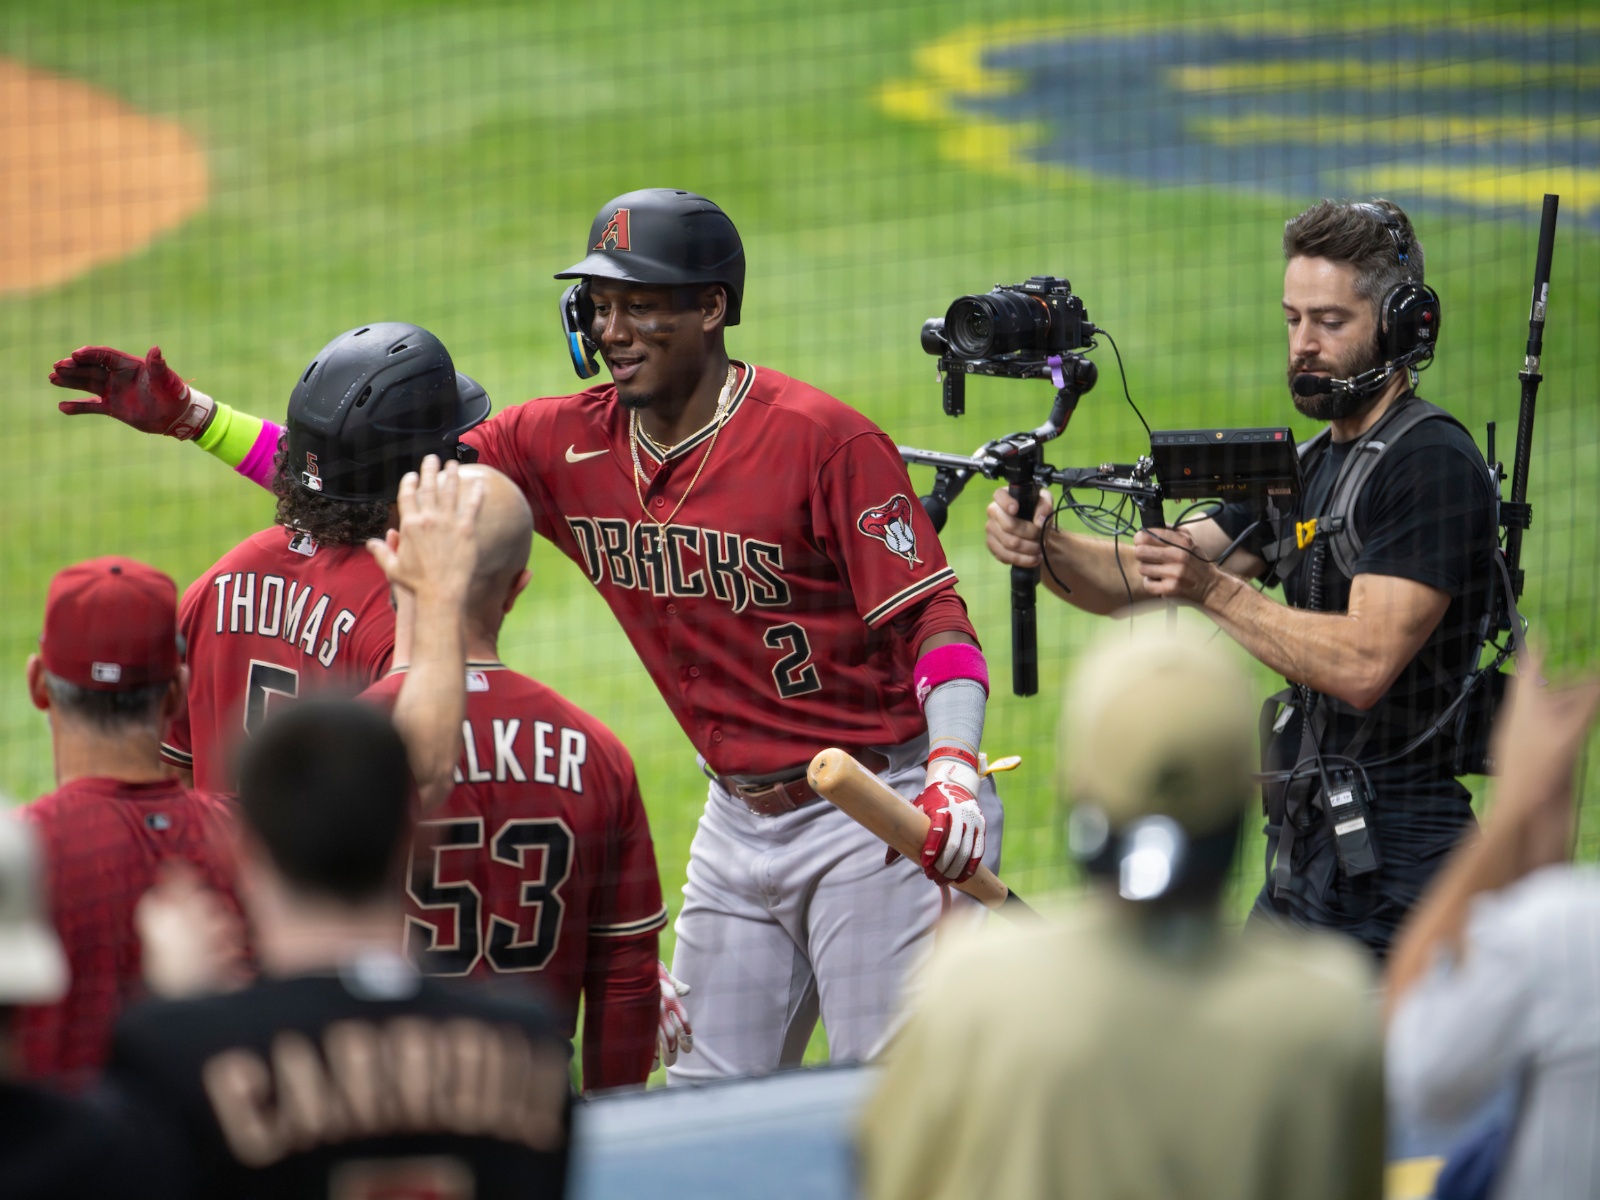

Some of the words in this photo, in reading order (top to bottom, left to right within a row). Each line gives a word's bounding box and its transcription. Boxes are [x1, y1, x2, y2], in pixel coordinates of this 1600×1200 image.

[593, 208, 631, 251] A
[306, 451, 319, 477] 5
[214, 571, 357, 669] THOMAS
[762, 621, 822, 699] 2
[452, 718, 588, 795] LKER
[402, 815, 576, 978] 53
